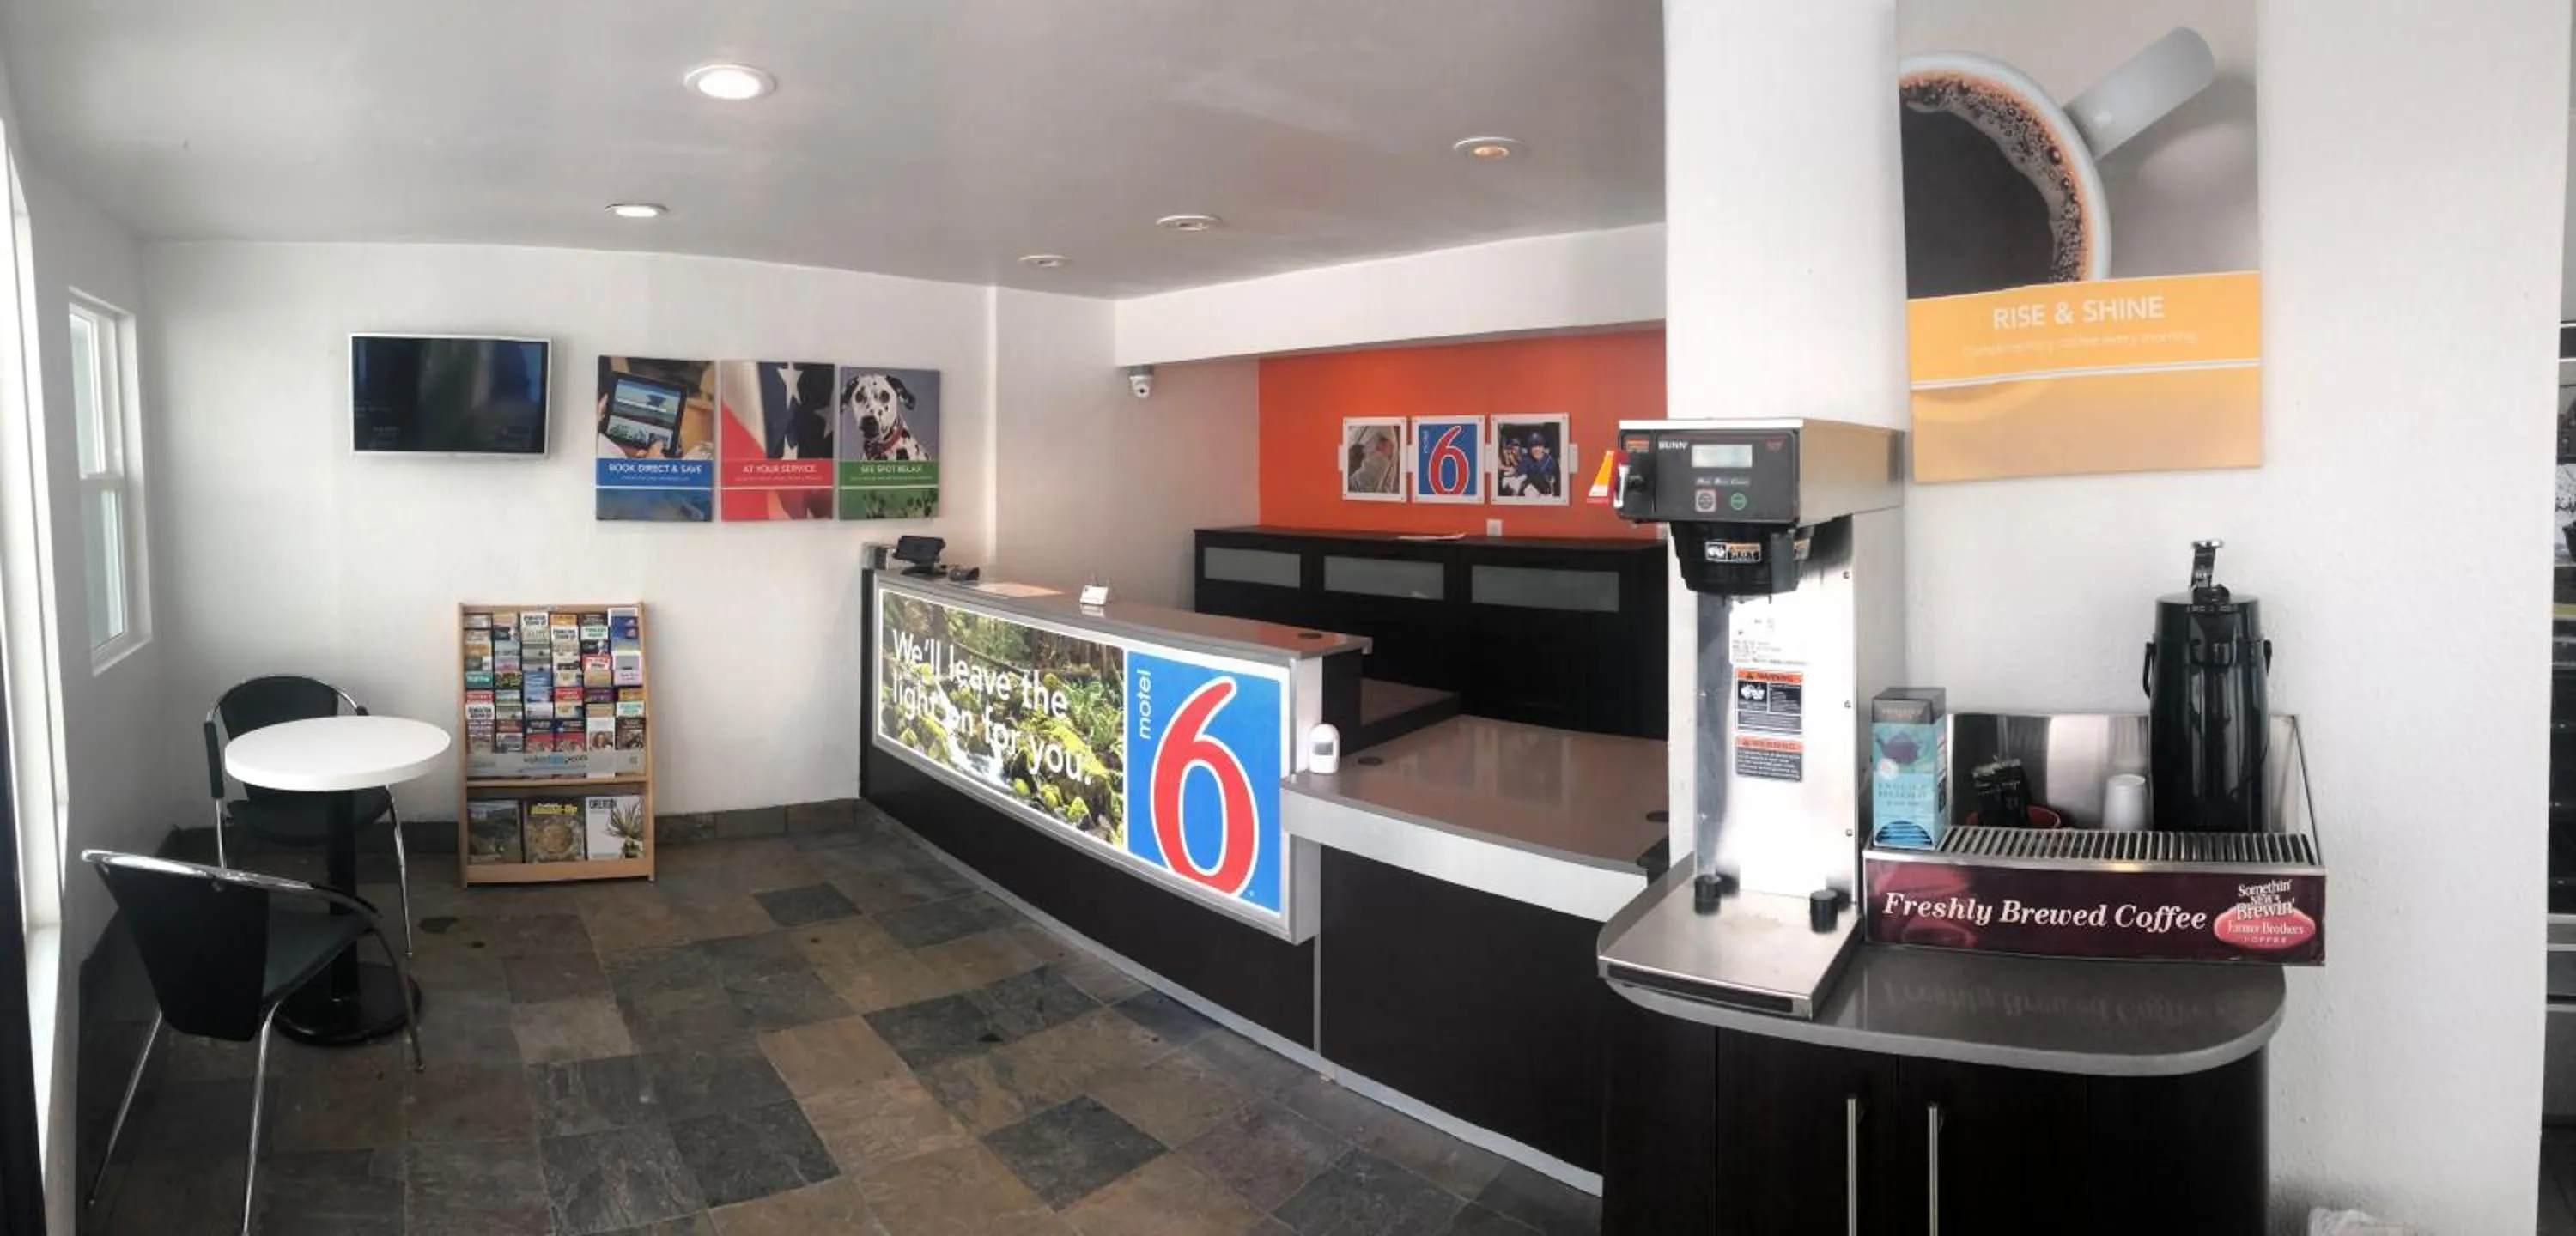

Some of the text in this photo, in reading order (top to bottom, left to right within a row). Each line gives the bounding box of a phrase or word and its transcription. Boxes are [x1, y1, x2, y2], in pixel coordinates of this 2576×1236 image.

[1993, 295, 2165, 330] RISE & SHINE
[1429, 425, 1470, 494] 6
[1658, 440, 1688, 450] BUNN
[609, 464, 635, 473] BOOK
[638, 464, 670, 473] DIRECT
[681, 464, 702, 474] SAVE
[743, 464, 817, 473] AT YOUR SERVICE
[893, 629, 1068, 718] We'll leave the
[892, 667, 1091, 785] light on for you.
[1137, 669, 1260, 900] motel 6
[2238, 879, 2293, 897] Somethin'
[1882, 892, 2207, 933] Freshly Brewed Coffee
[2236, 897, 2295, 920] Brewin'
[2262, 921, 2304, 935] Brothers
